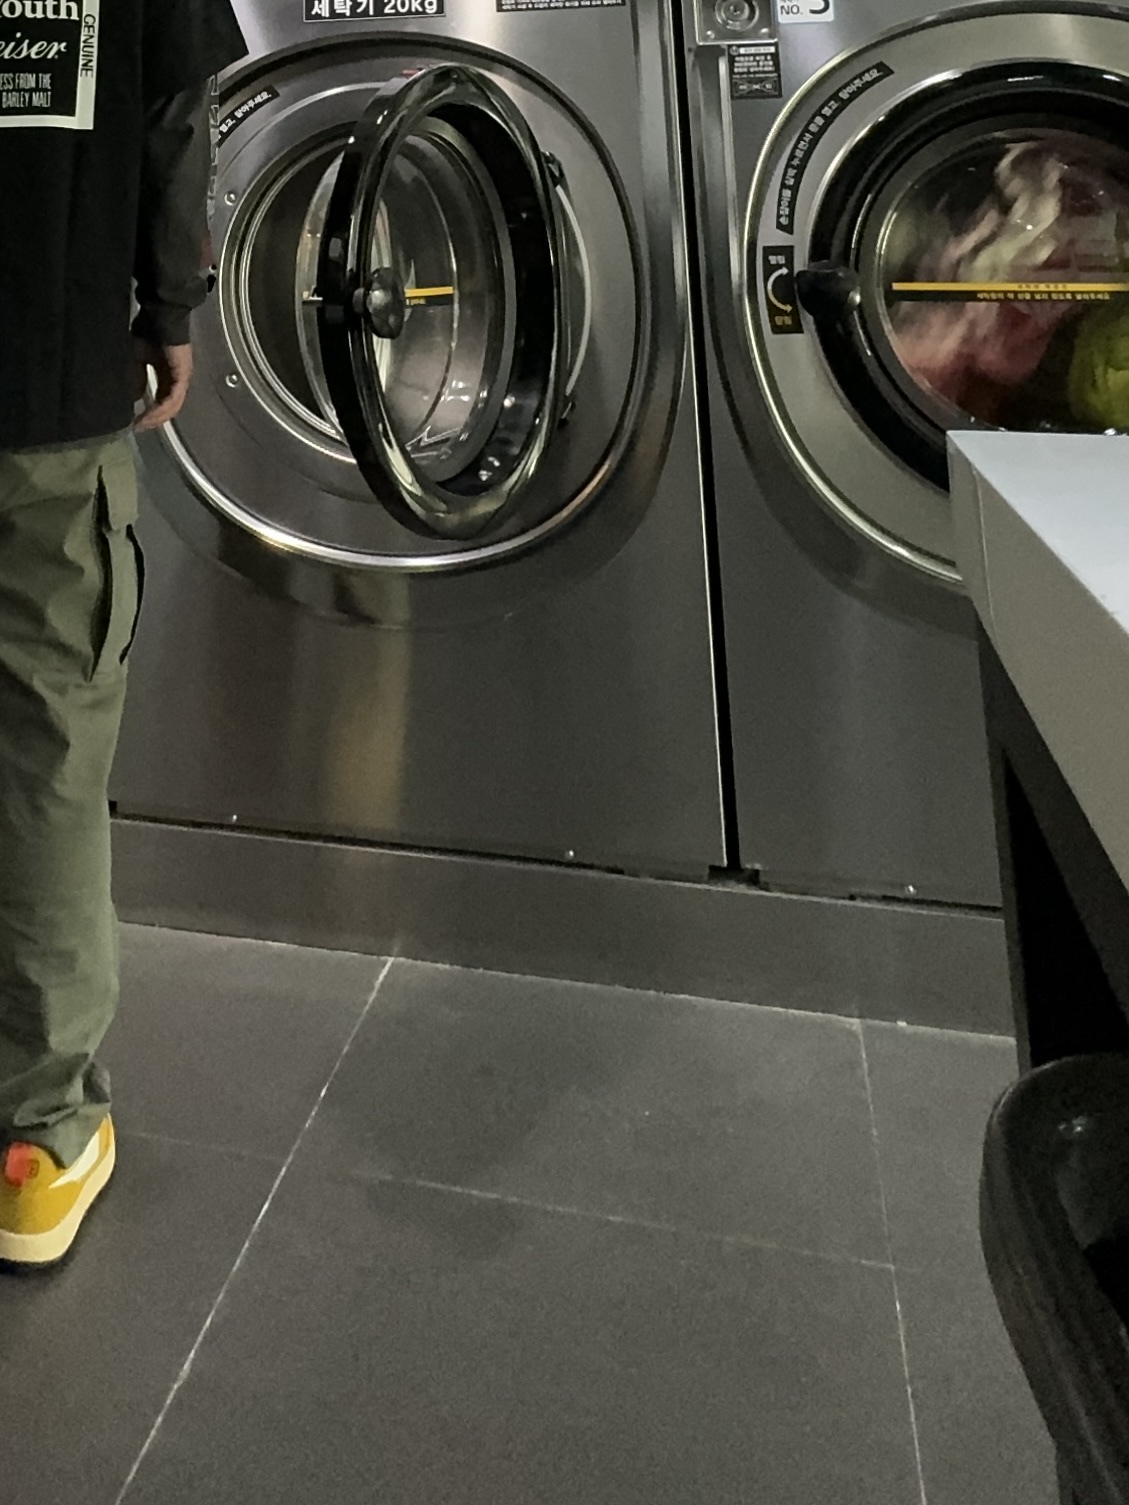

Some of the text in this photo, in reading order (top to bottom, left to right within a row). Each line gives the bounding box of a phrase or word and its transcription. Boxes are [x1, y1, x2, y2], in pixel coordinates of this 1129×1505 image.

[780, 4, 803, 16] NO.
[80, 13, 97, 78] GENUINE
[15, 73, 36, 89] FROM
[38, 72, 52, 89] THE
[2, 91, 30, 109] BARLEY
[32, 91, 51, 108] MALT
